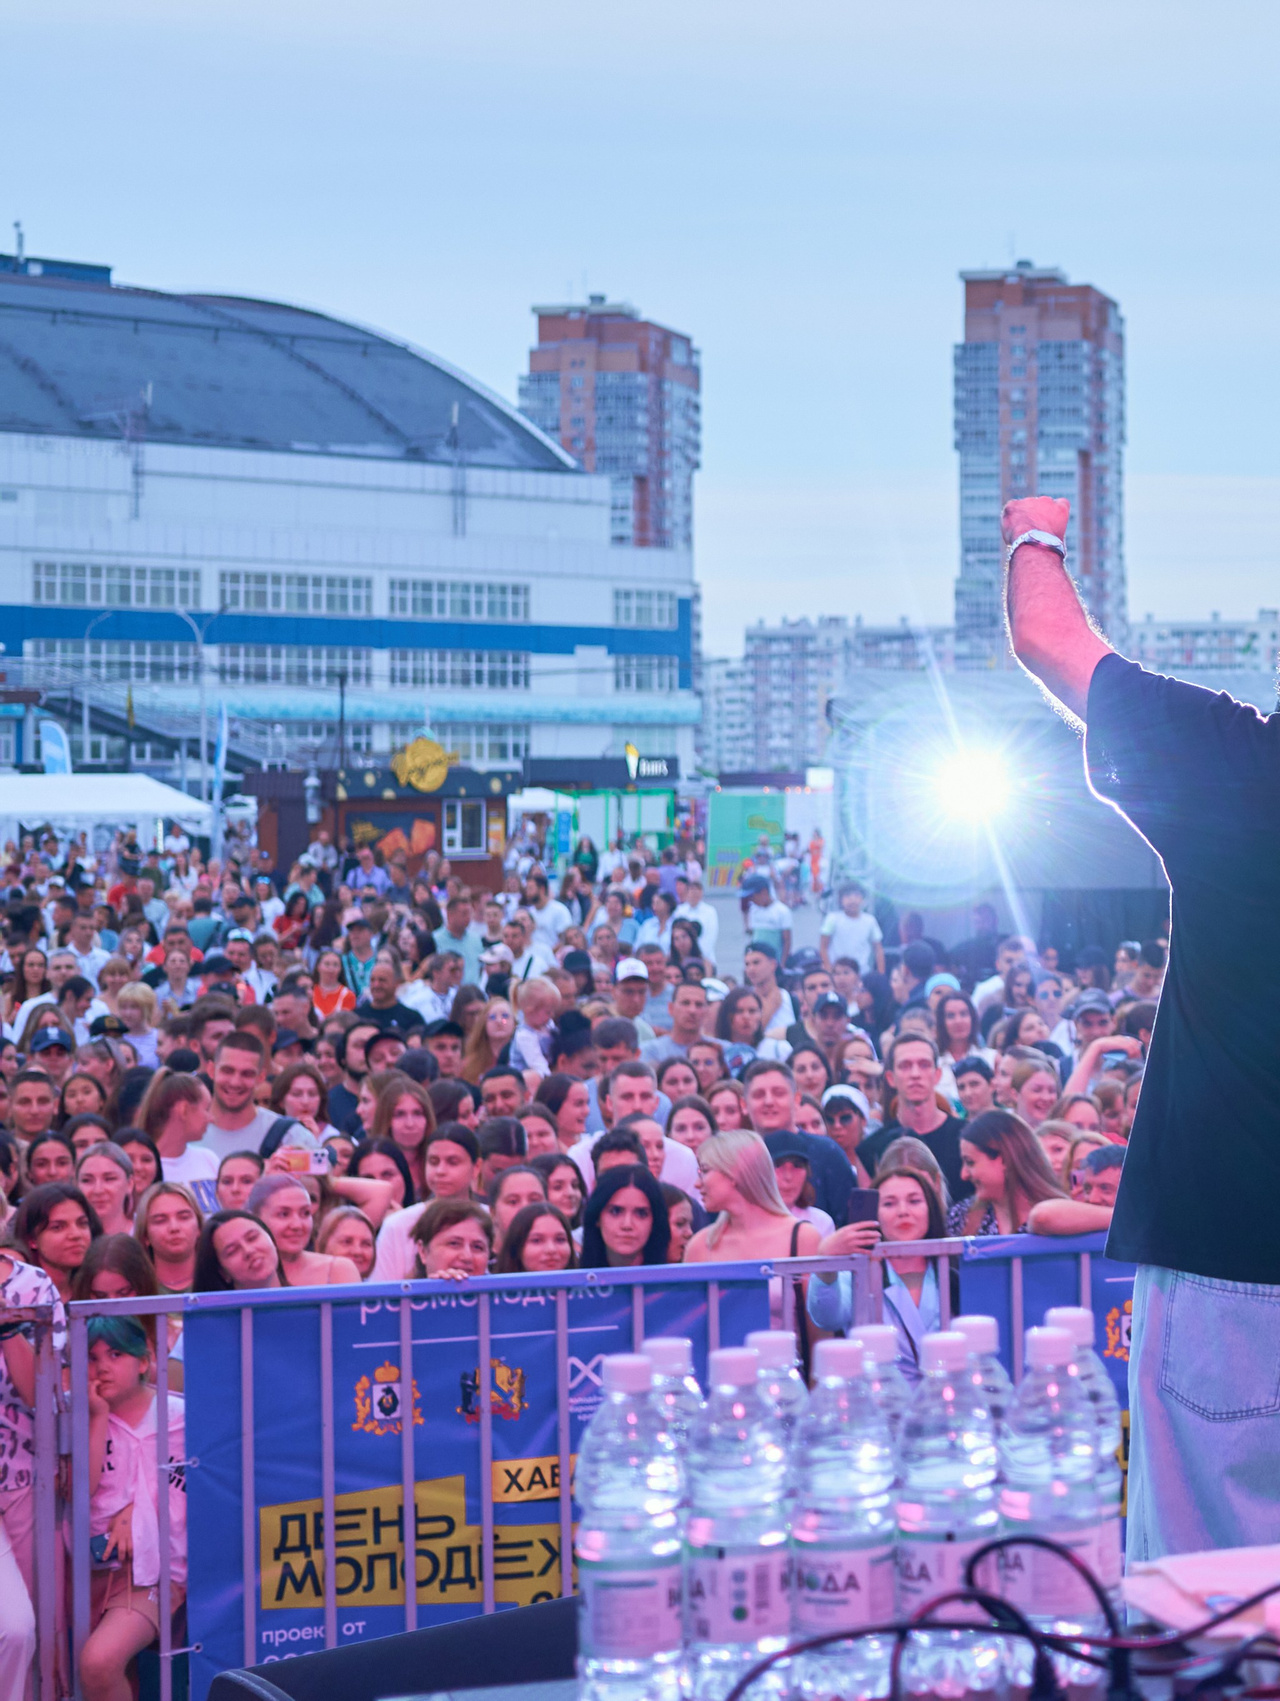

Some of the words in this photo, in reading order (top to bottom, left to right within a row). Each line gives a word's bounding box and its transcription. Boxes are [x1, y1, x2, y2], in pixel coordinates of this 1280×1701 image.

[273, 1503, 456, 1561] ДЕНЬ
[262, 1624, 328, 1647] проек
[342, 1620, 367, 1636] от
